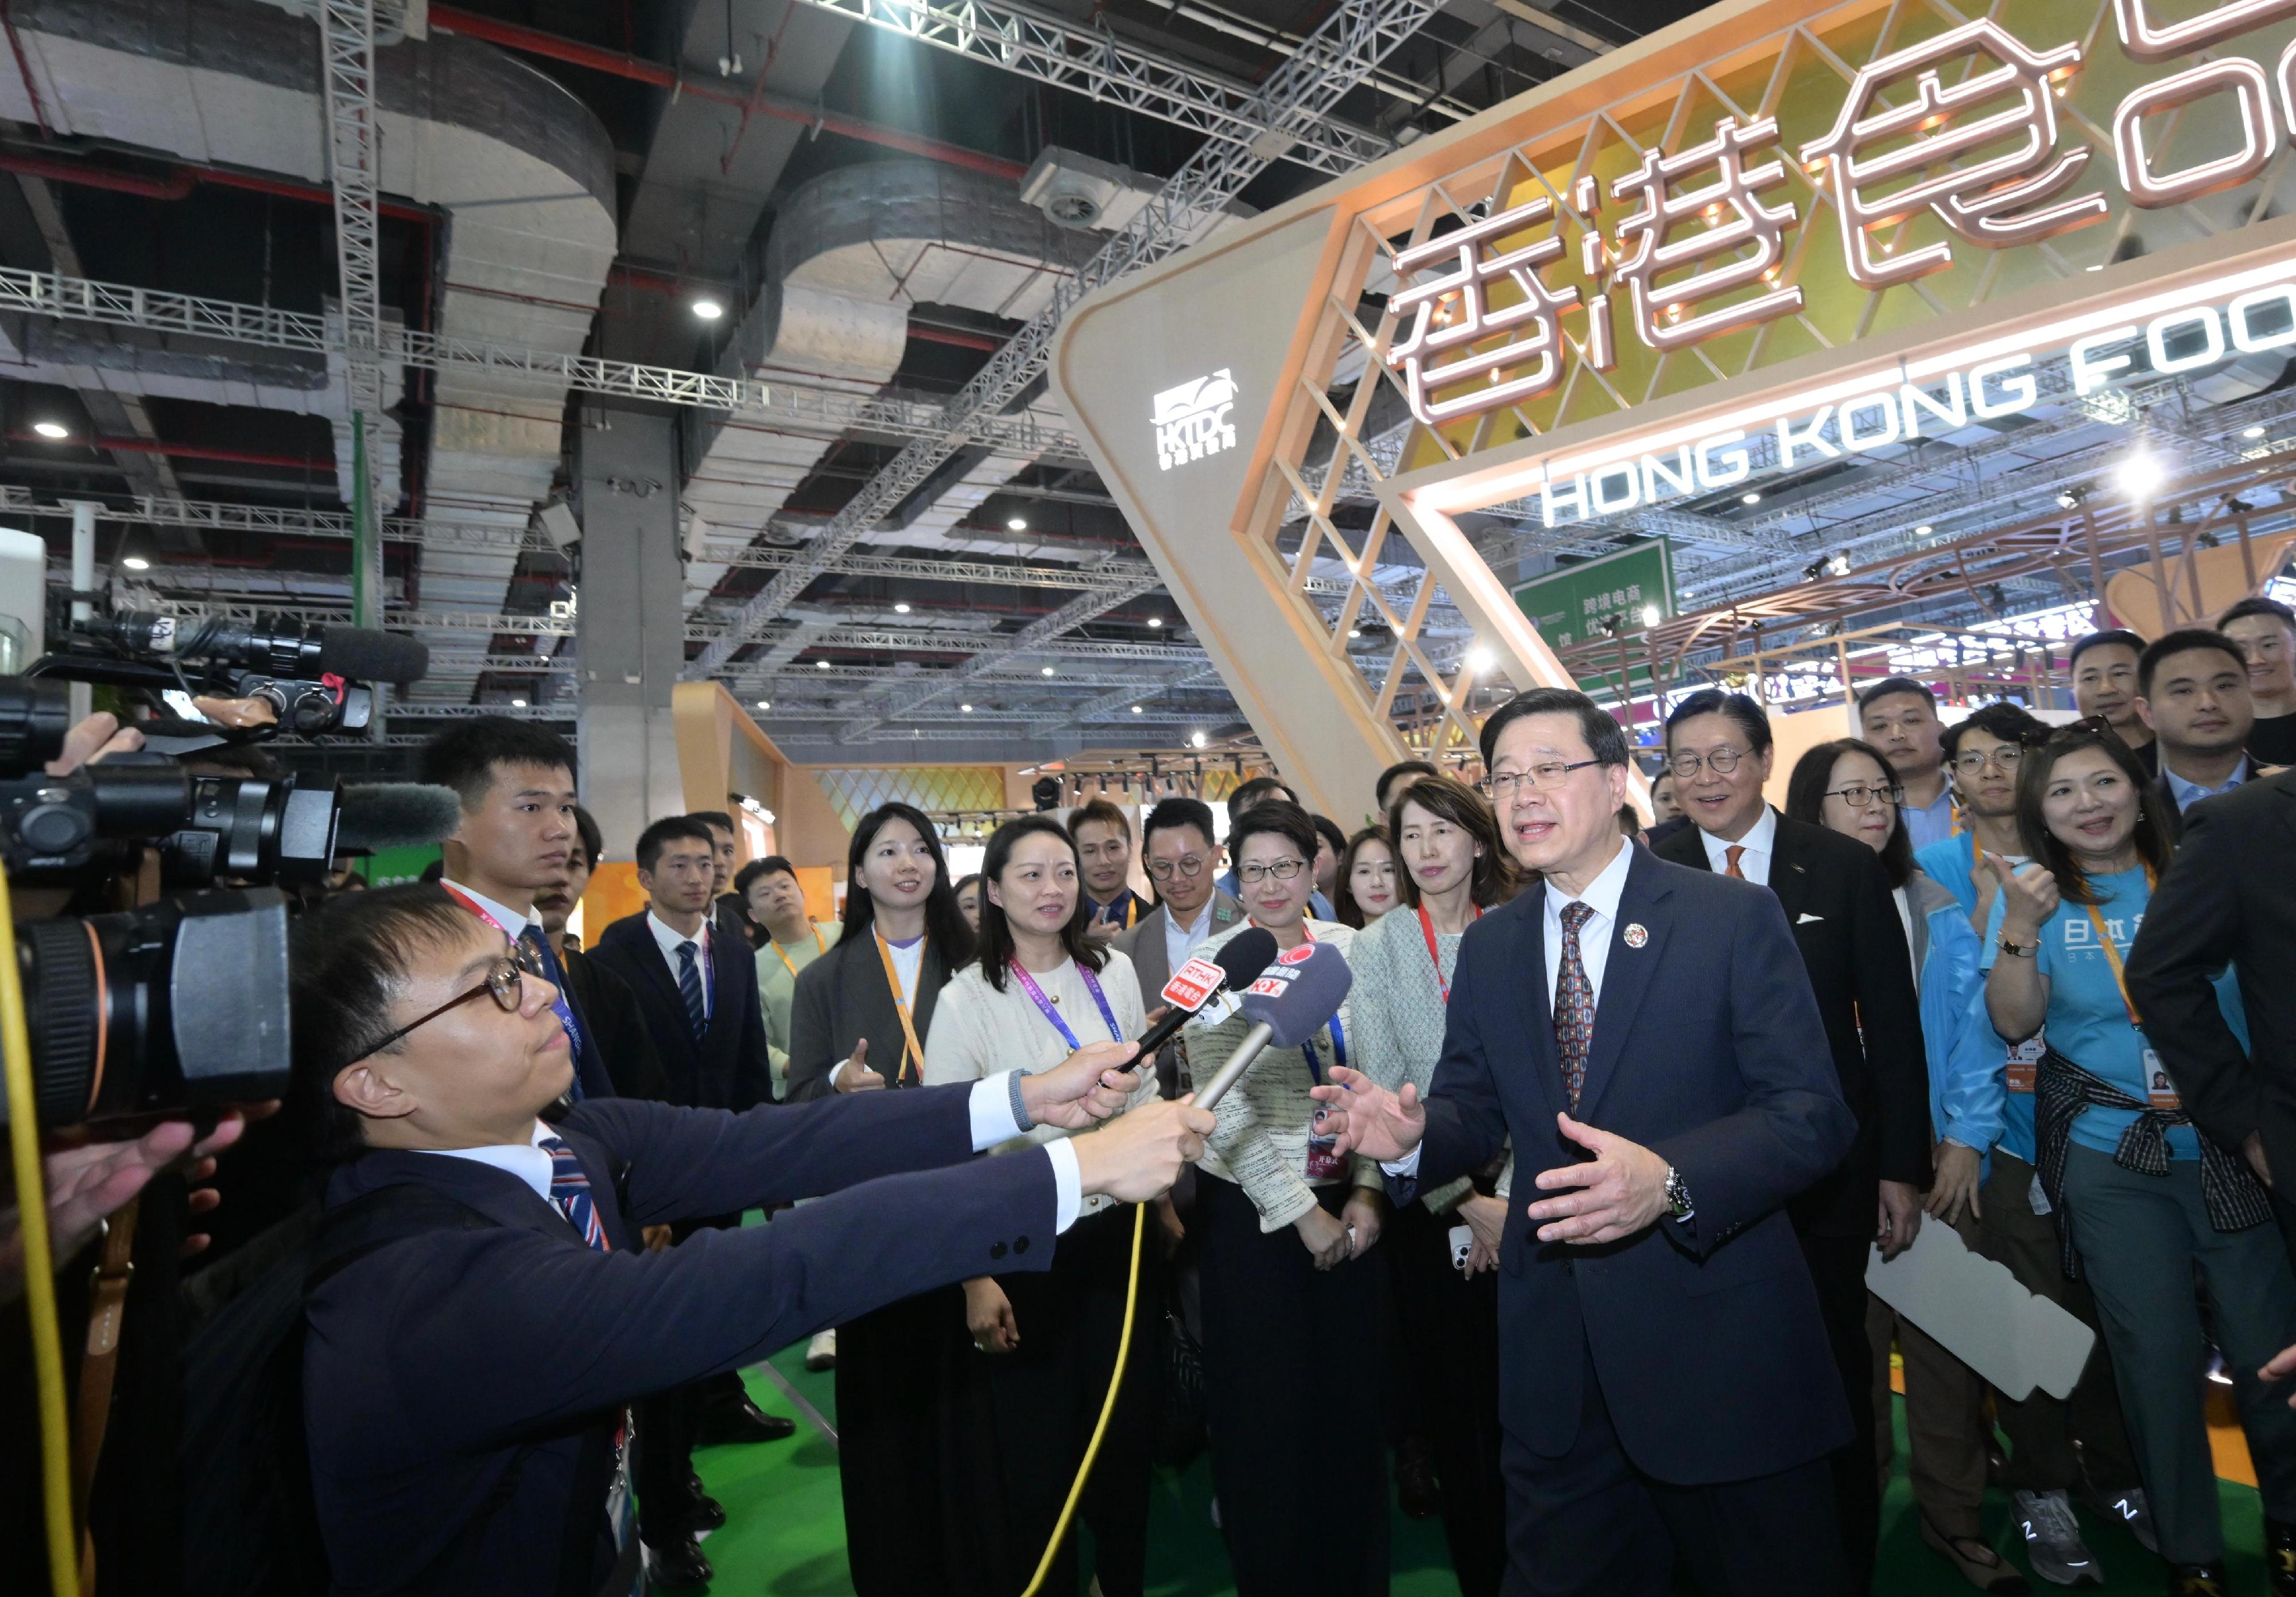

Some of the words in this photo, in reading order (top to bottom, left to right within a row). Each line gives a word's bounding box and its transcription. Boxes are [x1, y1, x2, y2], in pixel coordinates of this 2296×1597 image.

[1157, 402, 1235, 455] HKTDC
[1541, 429, 1750, 529] HONG
[1776, 352, 2038, 470] KONG
[1583, 584, 1642, 615] 跨境电商
[2065, 913, 2144, 943] 日本
[1183, 965, 1216, 985] RTHK
[1169, 980, 1201, 1002] 香港電台
